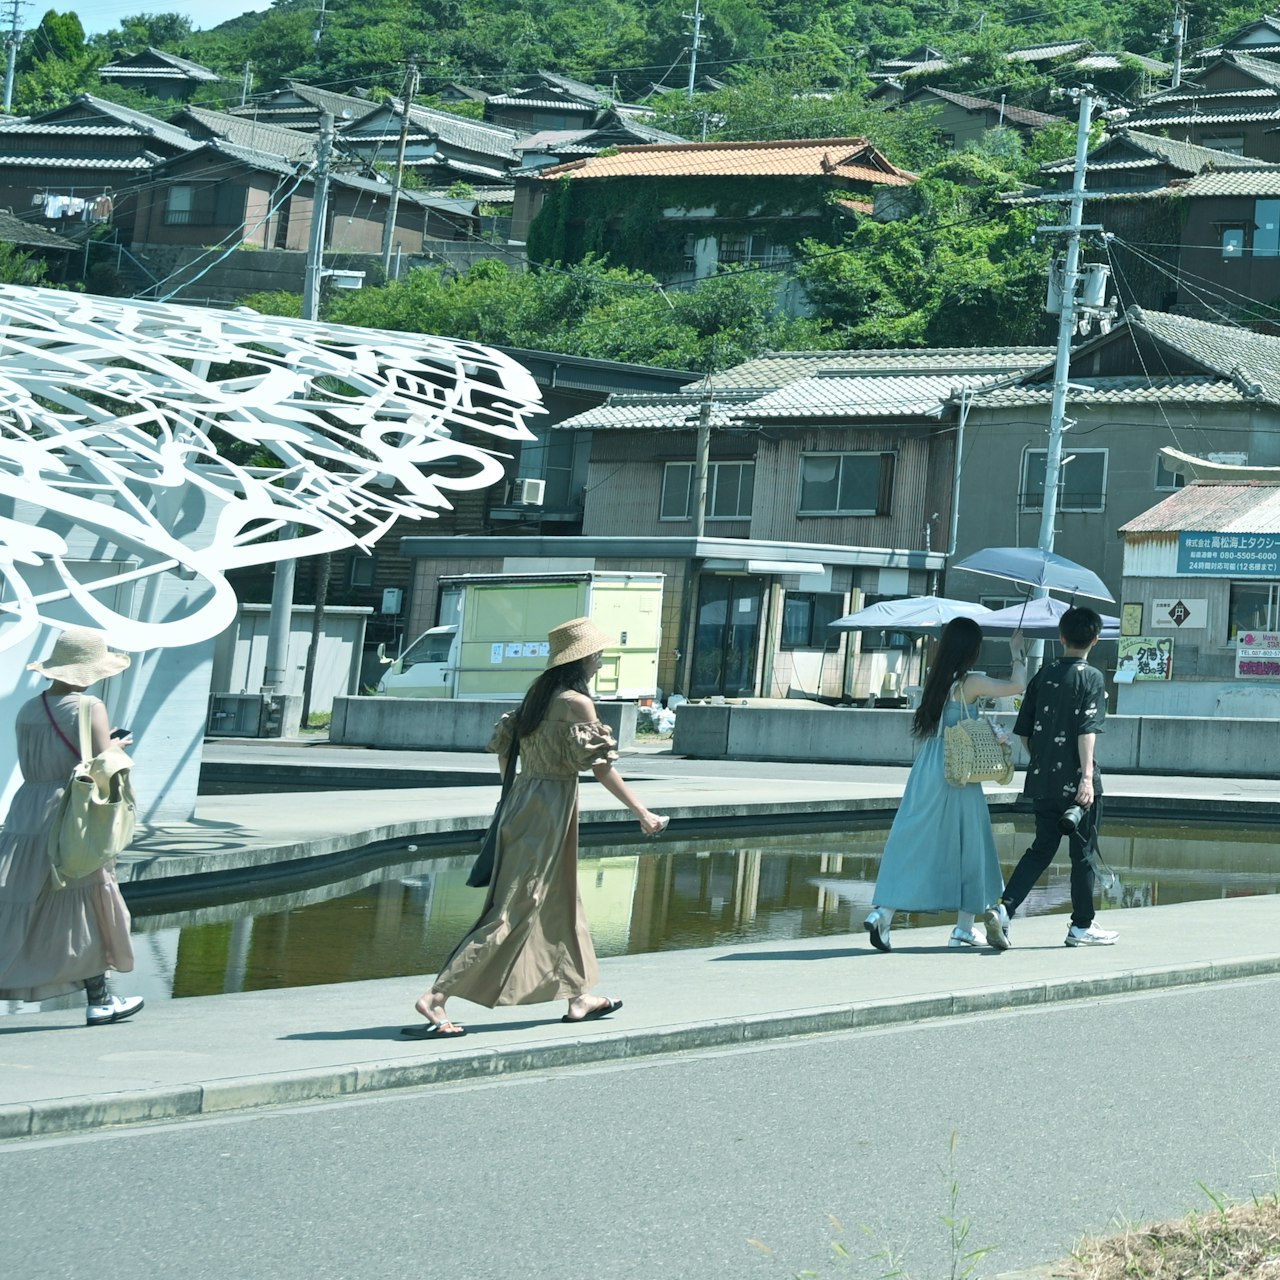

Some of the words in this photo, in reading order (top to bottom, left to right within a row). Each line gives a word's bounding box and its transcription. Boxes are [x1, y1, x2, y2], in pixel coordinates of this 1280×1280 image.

[1185, 538, 1211, 548] 株式会社
[1219, 551, 1278, 560] 080-5505-6000
